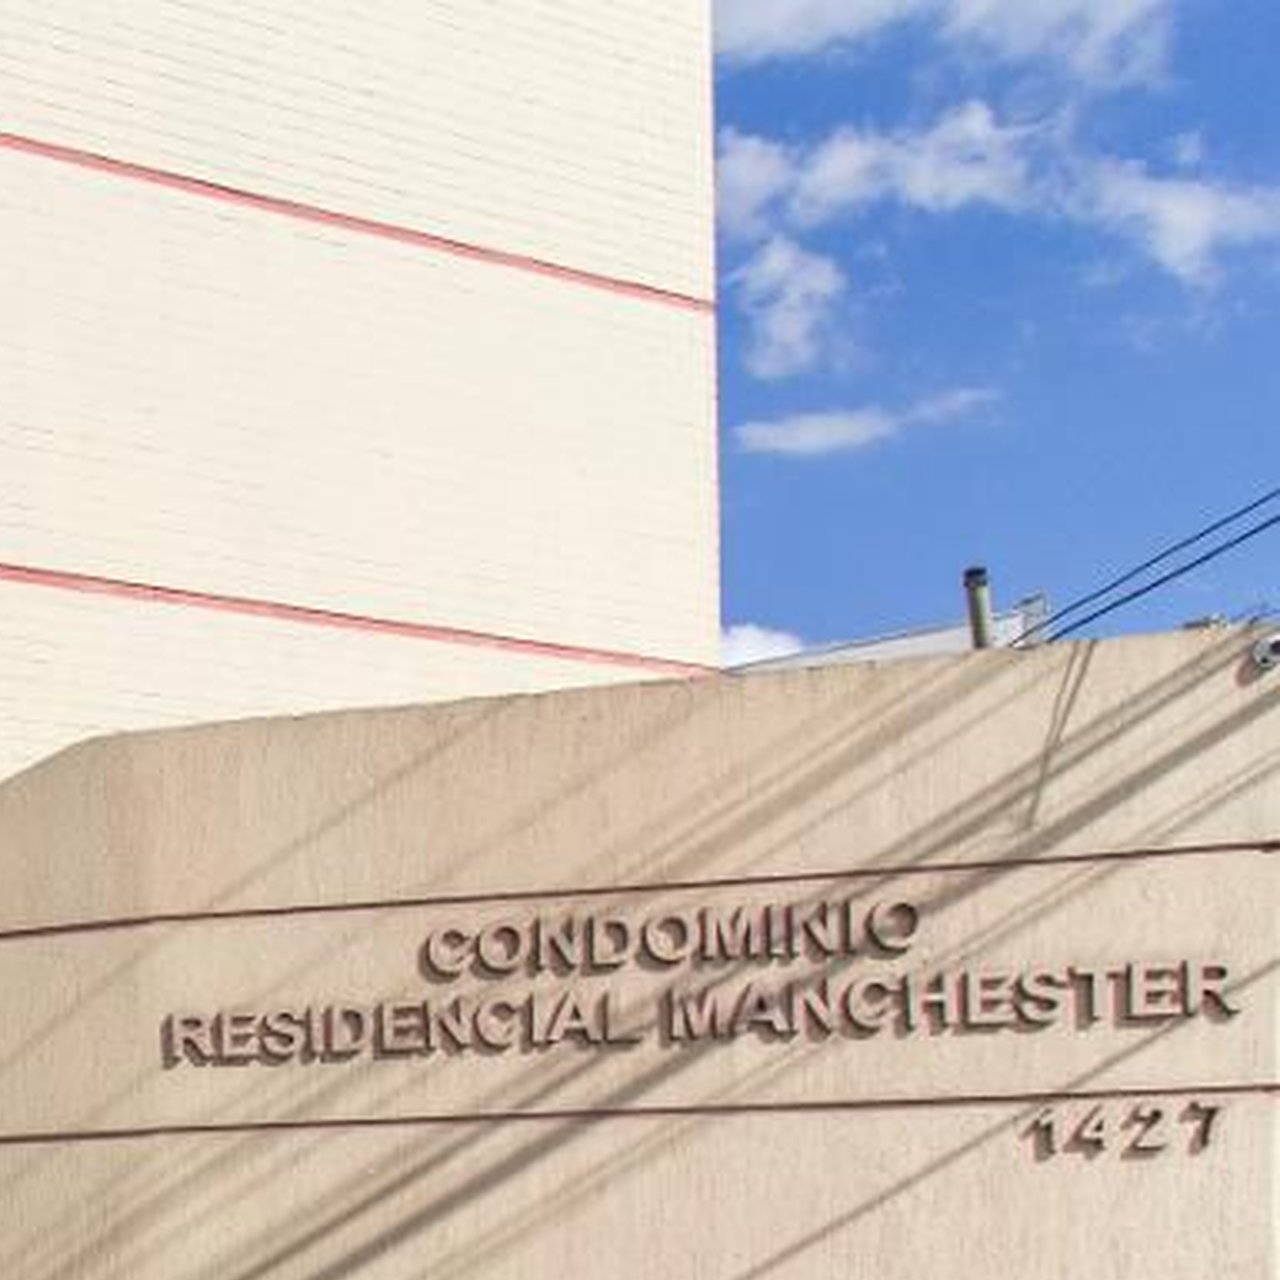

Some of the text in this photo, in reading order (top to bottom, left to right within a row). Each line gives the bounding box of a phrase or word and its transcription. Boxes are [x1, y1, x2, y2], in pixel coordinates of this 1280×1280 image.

[419, 900, 920, 983] CONDOMINIO
[160, 958, 1240, 1069] RESIDENCIAL MANCHESTER
[1020, 1101, 1222, 1162] 1427
